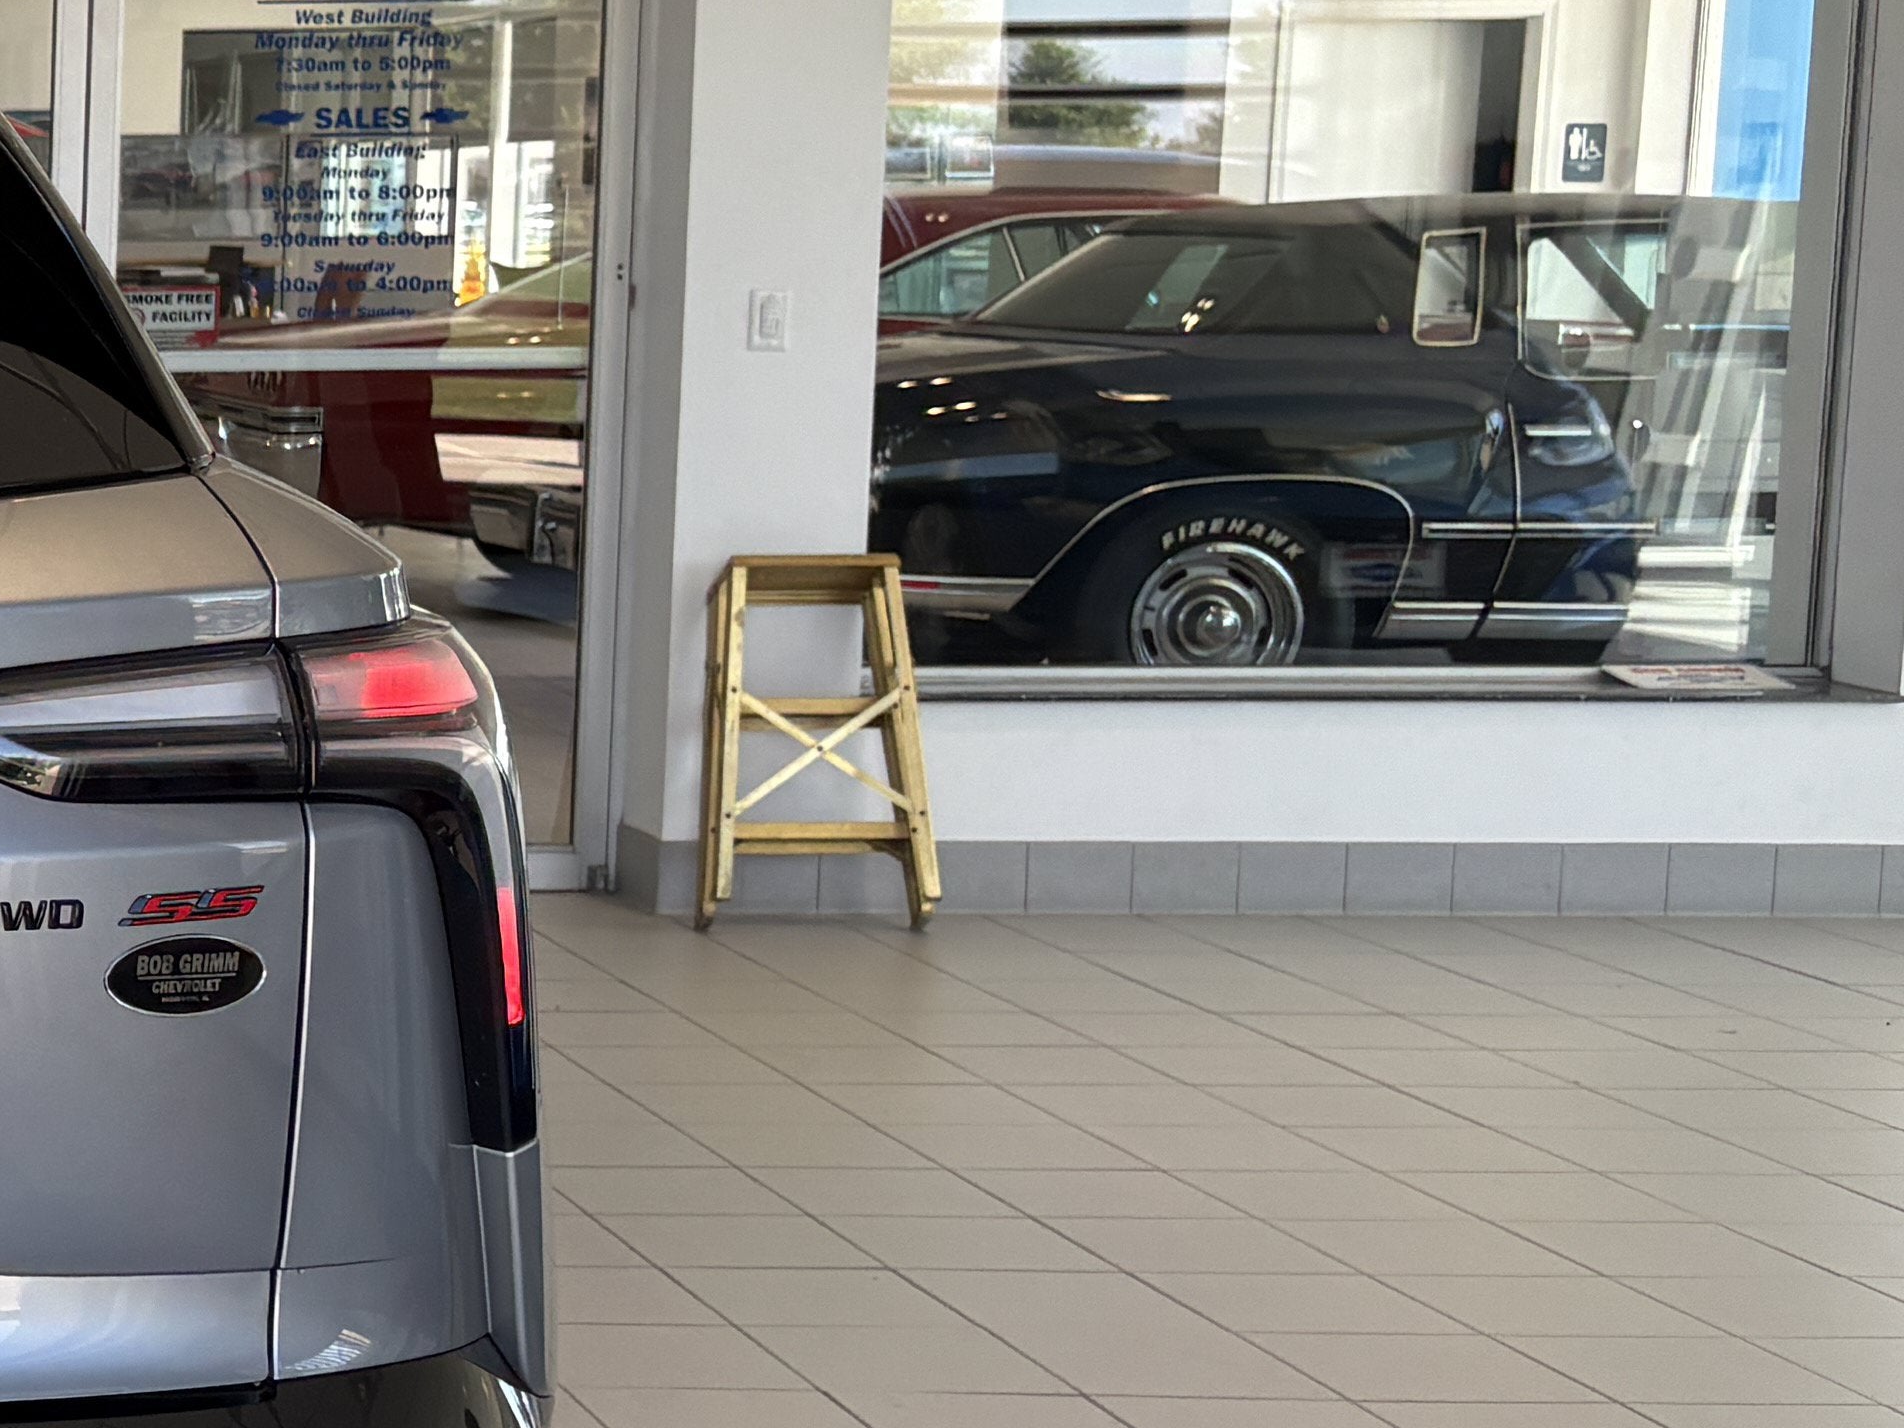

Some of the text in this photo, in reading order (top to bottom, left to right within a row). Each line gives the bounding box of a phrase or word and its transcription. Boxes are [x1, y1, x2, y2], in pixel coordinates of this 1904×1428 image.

[295, 8, 433, 27] West Building
[254, 29, 465, 52] Monday thru Friday
[352, 56, 372, 71] to
[324, 79, 382, 94] Saturday
[315, 107, 411, 129] SALES
[295, 141, 428, 160] East Building
[321, 166, 391, 182] Monday
[348, 185, 371, 200] to
[351, 209, 387, 223] thru
[392, 209, 446, 224] Friday
[347, 232, 369, 247] to
[314, 259, 395, 276] Saturday
[346, 277, 367, 292] to
[375, 276, 453, 294] 4:00pm
[176, 293, 213, 305] FREE
[152, 310, 212, 323] FACILITY
[1161, 517, 1305, 561] FIREHAWK
[117, 884, 265, 927] SS
[136, 950, 241, 976] BOB GRIMM
[152, 979, 222, 995] CHEVROLET
